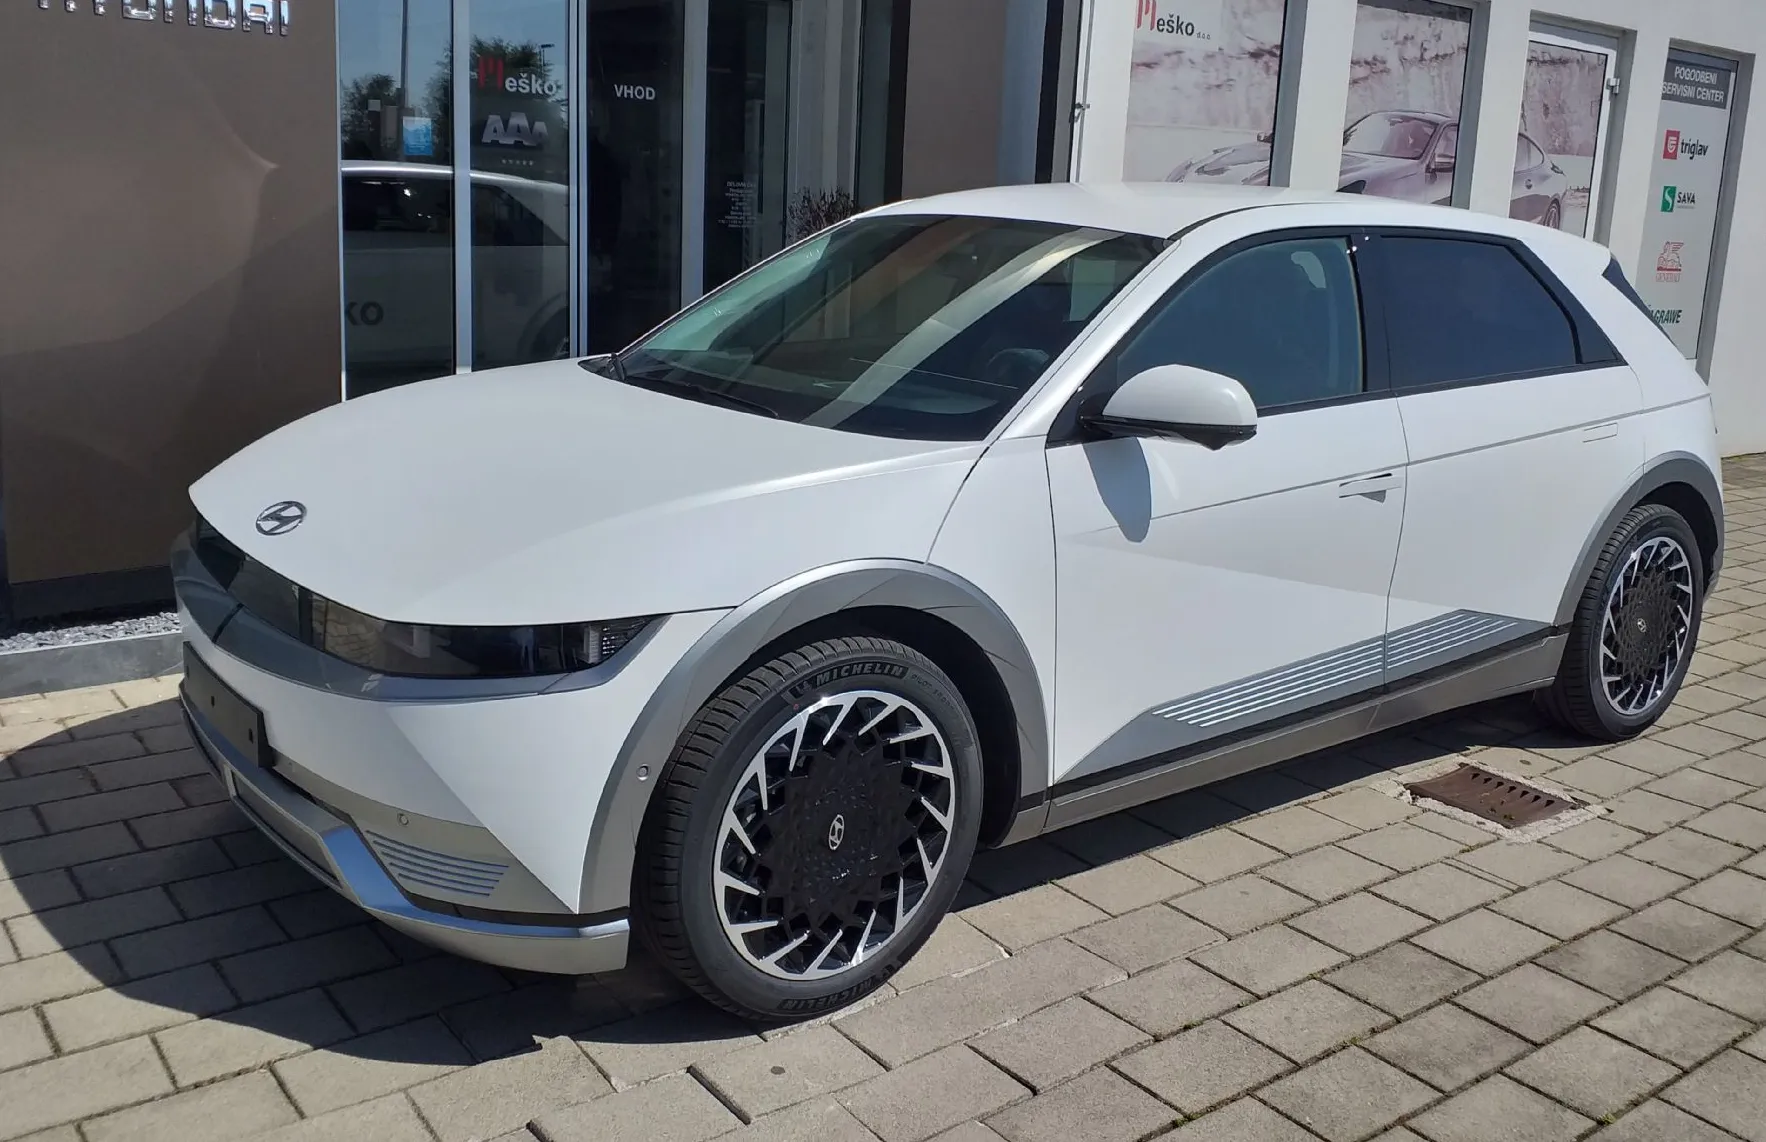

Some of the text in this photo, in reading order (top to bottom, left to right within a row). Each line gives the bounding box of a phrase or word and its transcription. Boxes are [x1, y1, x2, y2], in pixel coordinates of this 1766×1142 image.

[38, 0, 289, 35] UNDAI
[1674, 66, 1718, 84] POGODBENI
[614, 84, 656, 100] VHOD
[1661, 81, 1725, 102] SERVISNI CENTER
[1680, 139, 1709, 160] triglav
[1677, 192, 1696, 204] SAVA
[816, 662, 904, 687] MICHELIN
